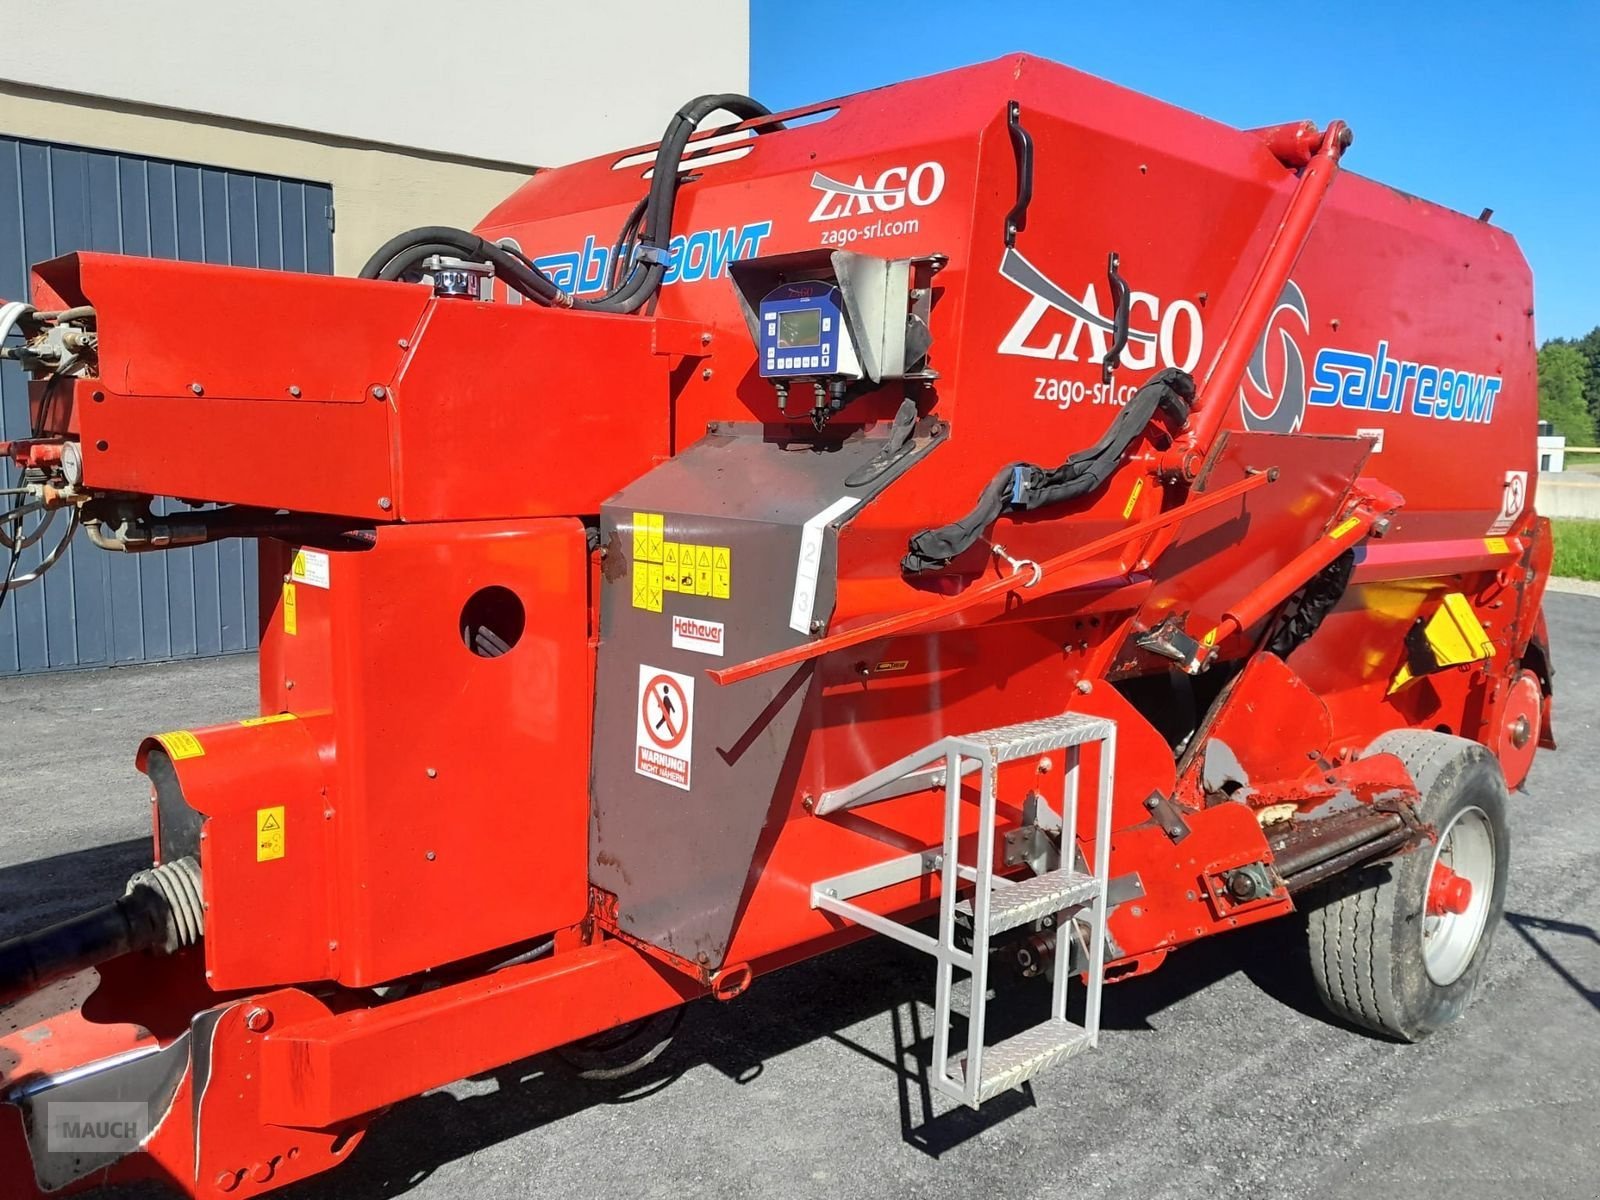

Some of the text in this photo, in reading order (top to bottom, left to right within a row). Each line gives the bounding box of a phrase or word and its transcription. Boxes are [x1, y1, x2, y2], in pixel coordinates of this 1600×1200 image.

[808, 161, 945, 222] ZAGO
[820, 218, 919, 246] zago-srl.com
[997, 247, 1204, 375] ZAGO
[1033, 376, 1140, 409] zago-srl.co
[1308, 340, 1503, 425] sabre90WT
[804, 542, 816, 564] 2
[799, 592, 809, 612] 3
[641, 748, 685, 772] WARNUNG!
[641, 761, 658, 774] NICHT
